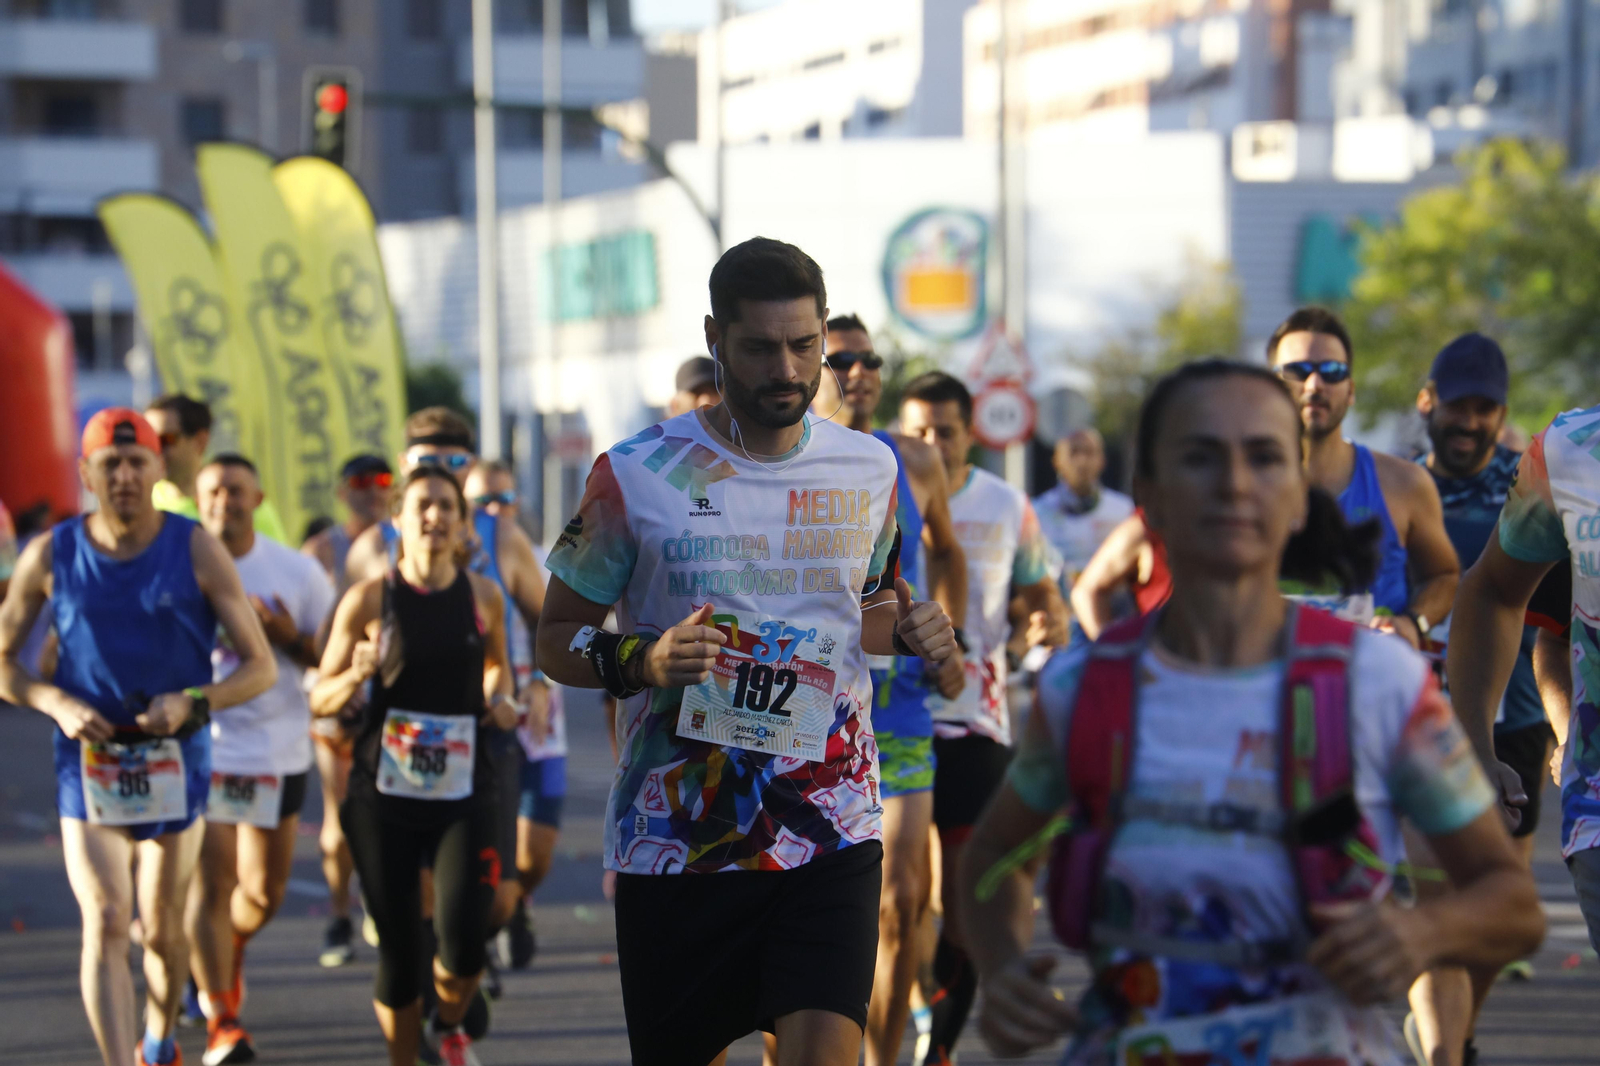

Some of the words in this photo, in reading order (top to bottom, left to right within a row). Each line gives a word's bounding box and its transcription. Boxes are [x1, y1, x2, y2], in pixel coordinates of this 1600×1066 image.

[786, 488, 871, 526] MEDIA
[662, 529, 770, 563] CÓRDOBA
[782, 523, 873, 559] MARATÓN
[667, 564, 797, 596] ALMODÓVAR
[802, 567, 847, 593] DEL
[732, 662, 797, 717] 192
[813, 678, 828, 690] RÍO
